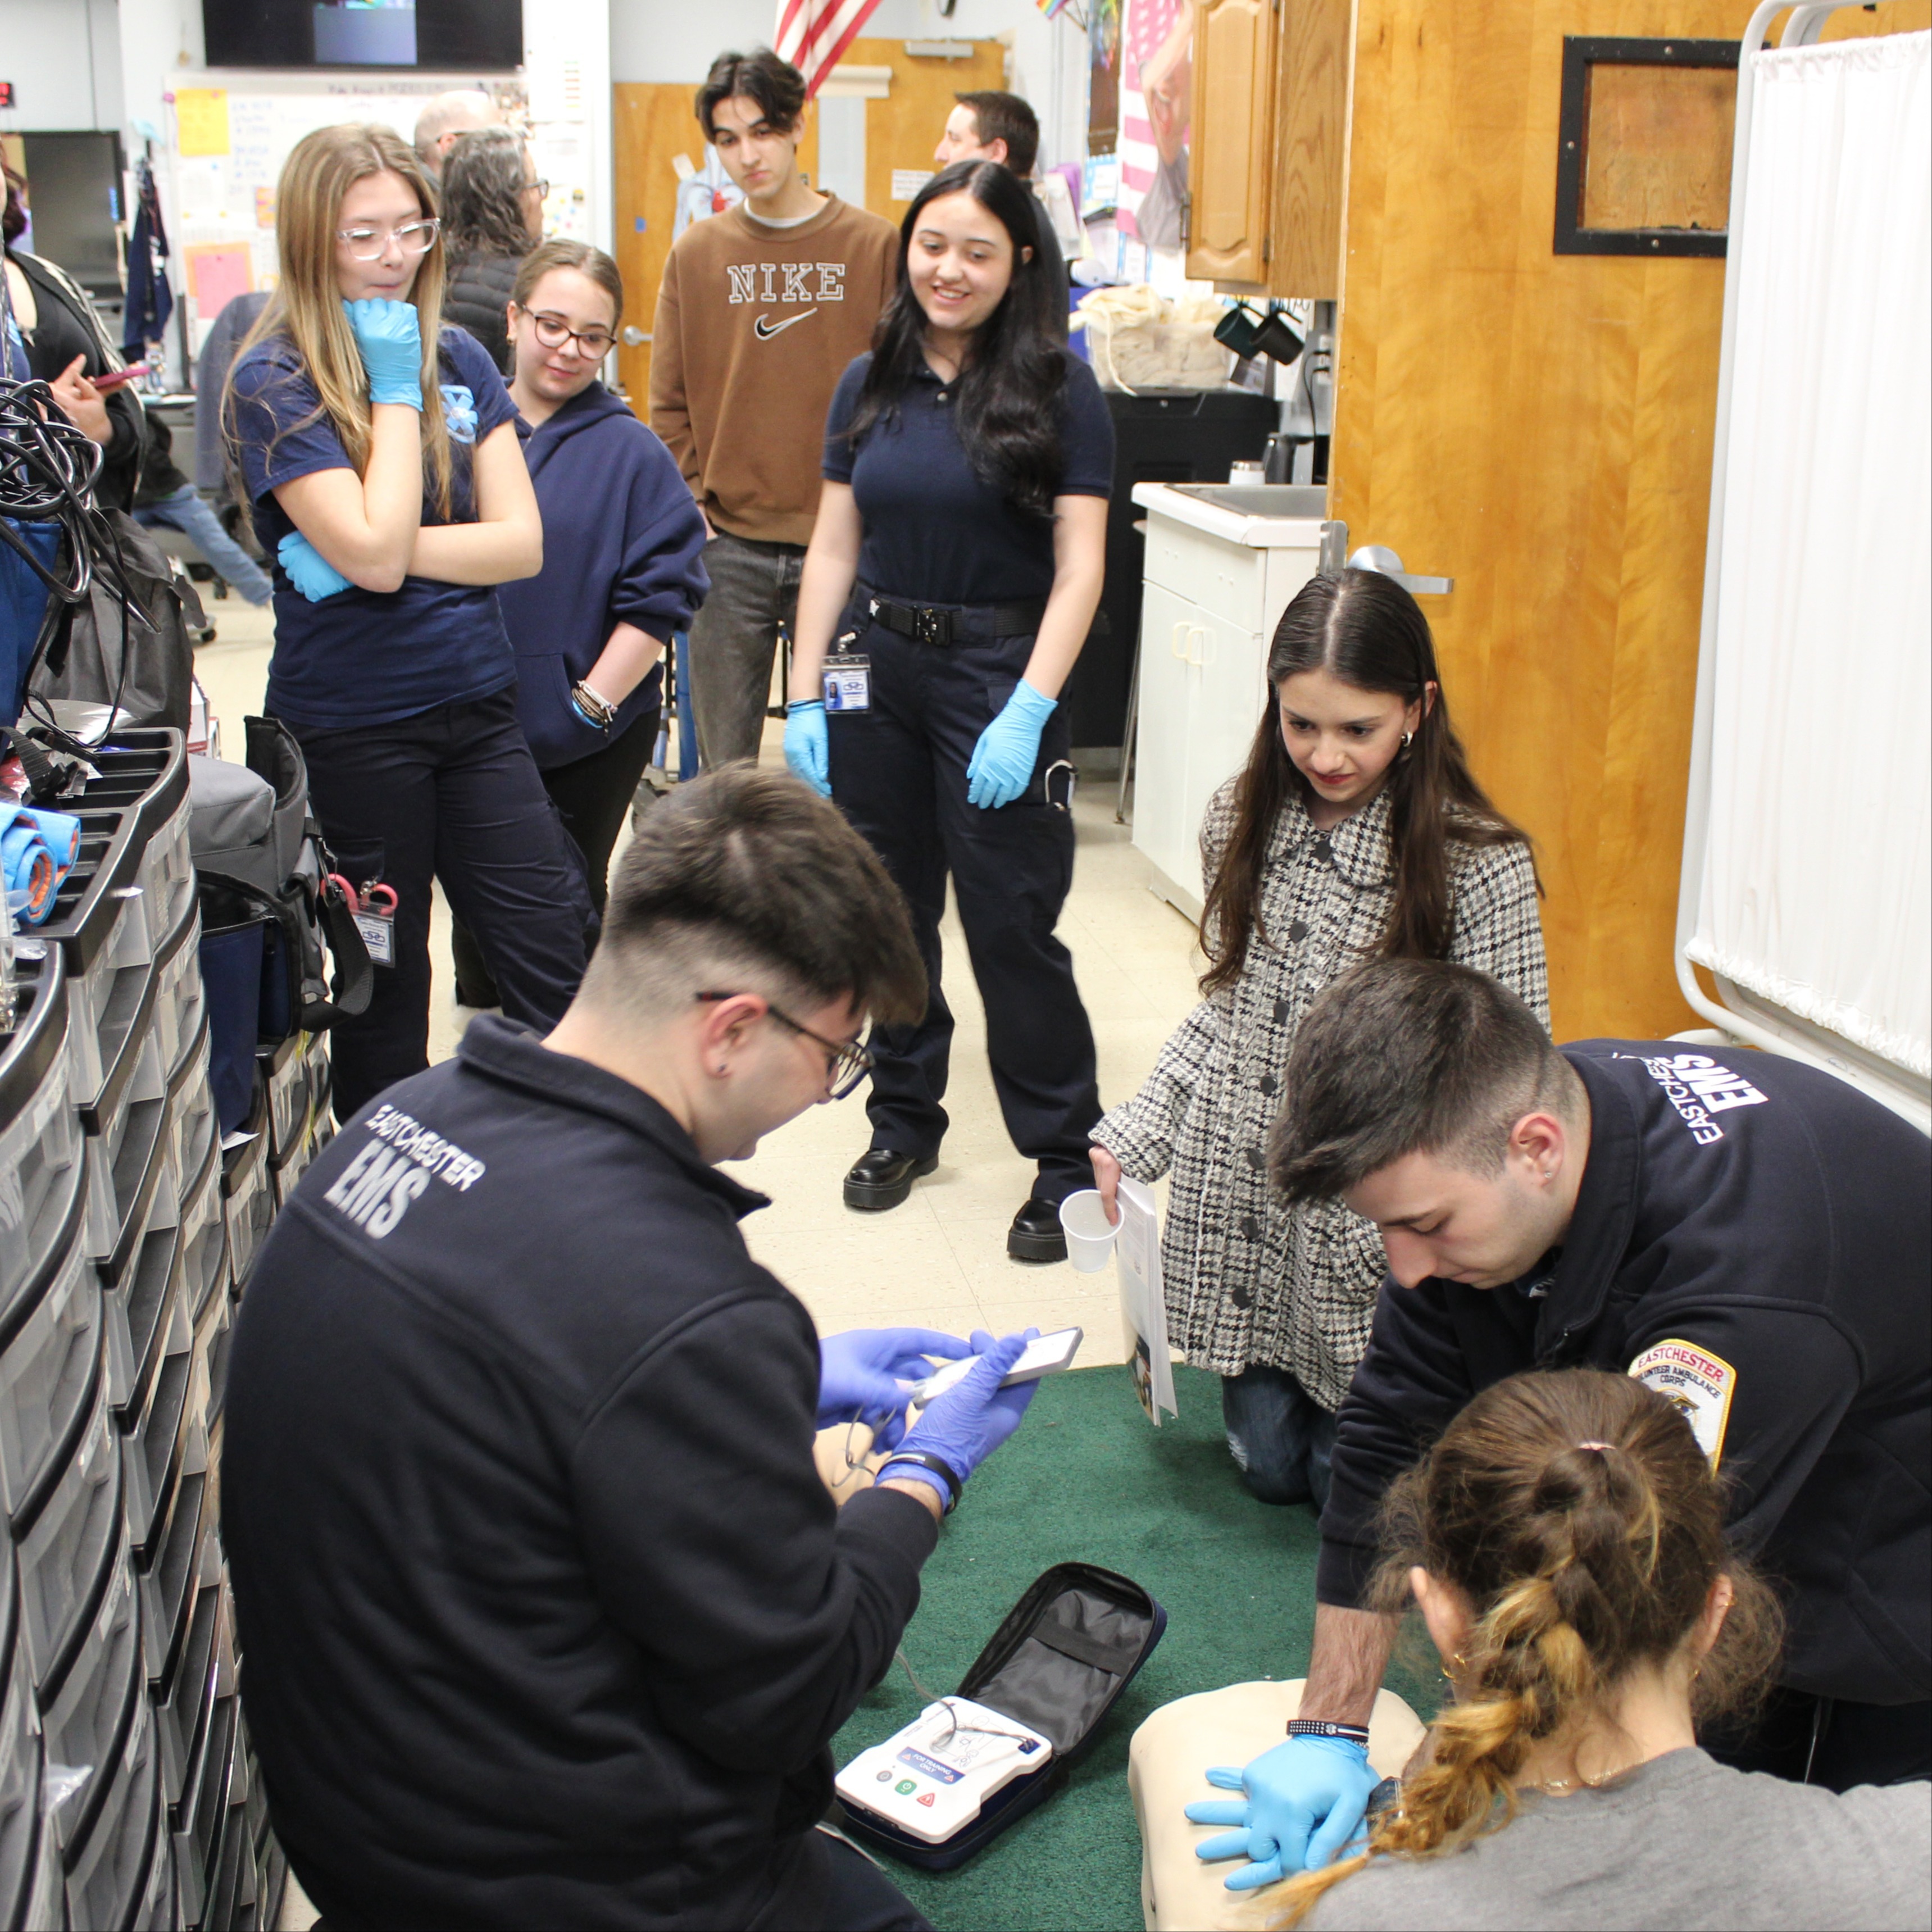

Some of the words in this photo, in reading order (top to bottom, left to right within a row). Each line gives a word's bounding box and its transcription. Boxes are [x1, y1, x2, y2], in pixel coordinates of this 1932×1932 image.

[727, 262, 845, 304] NIKE
[1612, 1052, 1725, 1145] EASTCHES
[1654, 1054, 1770, 1113] EMS
[365, 1104, 486, 1192] EASTCHESTER
[322, 1137, 431, 1239] EMS
[1637, 1365, 1670, 1380] LUNTEER
[1672, 1366, 1722, 1399] AMBULANCE
[1638, 1347, 1724, 1382] EASTCHESTER
[1660, 1374, 1686, 1387] CORPS
[912, 1753, 926, 1763] FOR
[925, 1758, 953, 1775] TRAINING
[919, 1762, 937, 1774] ONLY
